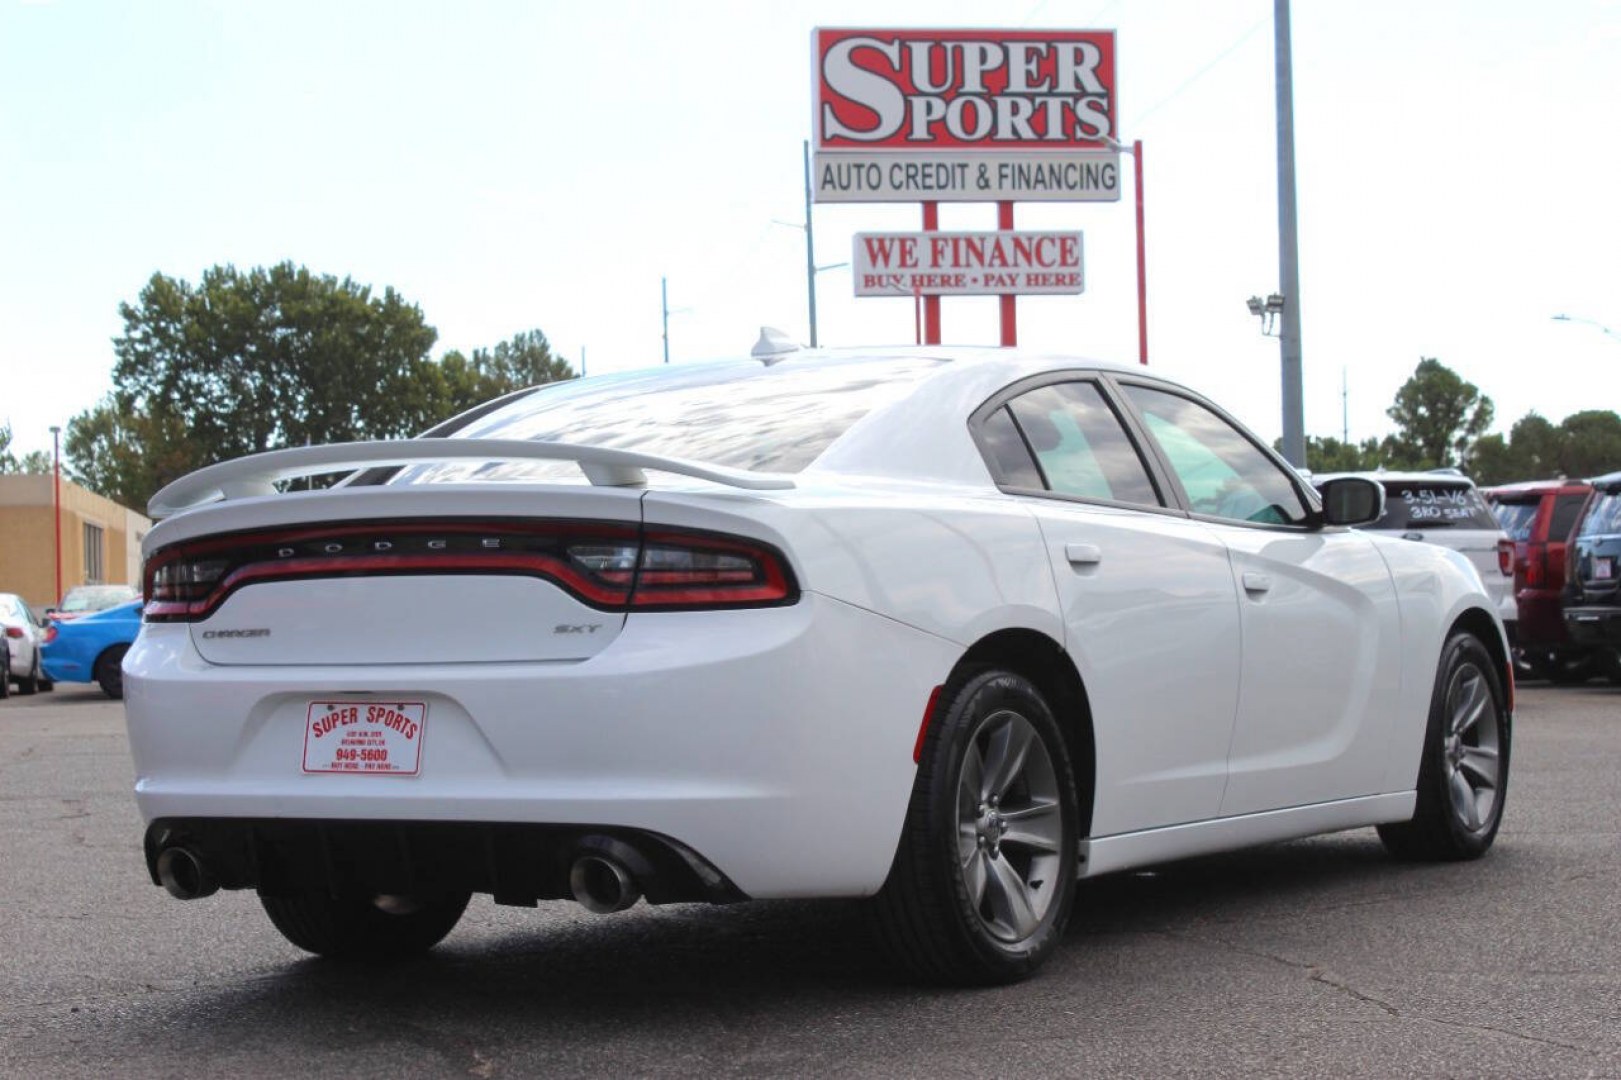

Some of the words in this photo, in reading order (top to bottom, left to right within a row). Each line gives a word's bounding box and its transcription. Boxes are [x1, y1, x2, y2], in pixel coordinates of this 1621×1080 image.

[822, 36, 1108, 142] SUPER
[821, 163, 882, 190] AUTO
[889, 163, 969, 190] CREDIT
[976, 163, 991, 191] &
[998, 163, 1116, 191] FINANCING
[863, 237, 919, 268] WE
[929, 236, 1080, 268] FINANCE
[863, 275, 904, 288] BUY
[911, 274, 967, 288] HERE
[983, 273, 1019, 287] PAY
[1026, 273, 1082, 287] HERE
[278, 538, 501, 558] DODGE
[553, 624, 603, 635] SXT
[312, 707, 359, 738] SUPER
[366, 705, 418, 740] SPORTS
[336, 747, 388, 761] 949-5600
